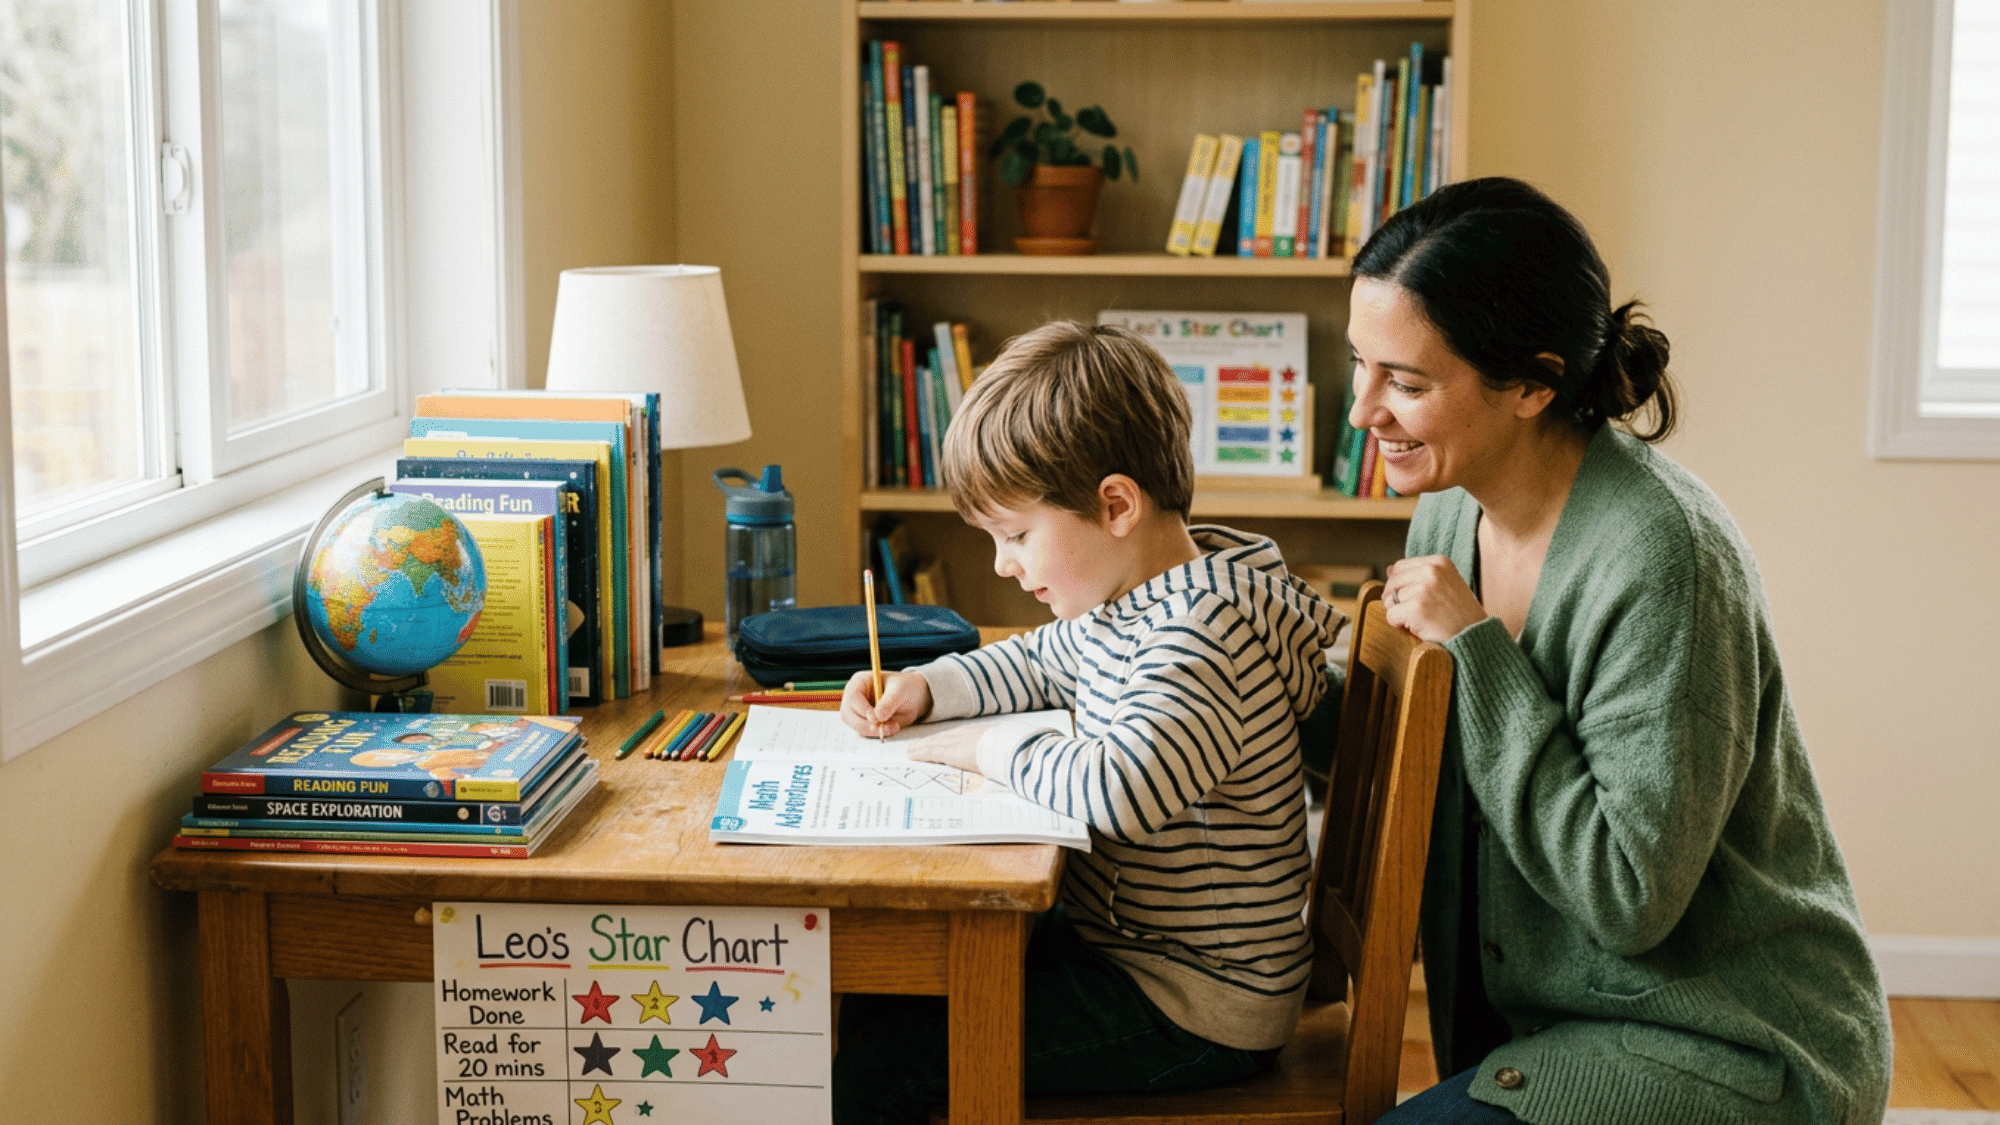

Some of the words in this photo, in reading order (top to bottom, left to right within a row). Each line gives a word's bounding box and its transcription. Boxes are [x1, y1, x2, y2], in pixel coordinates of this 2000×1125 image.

[1179, 318, 1222, 337] Star
[1228, 318, 1285, 338] Chart
[421, 492, 495, 515] ading
[500, 494, 533, 512] Fun
[293, 778, 357, 793] READING
[747, 780, 780, 811] Math
[266, 801, 309, 816] SPACE
[311, 803, 403, 819] EXPLORATION
[475, 914, 570, 961] Leo's
[588, 913, 670, 962] Star
[681, 916, 790, 967] Chart
[441, 979, 556, 1003] Homework
[469, 1004, 526, 1026] Done
[443, 1033, 498, 1055] Read
[507, 1032, 542, 1054] for
[458, 1058, 488, 1078] 20
[495, 1059, 545, 1077] mins
[445, 1086, 505, 1107] Math
[456, 1108, 553, 1125] Problems
